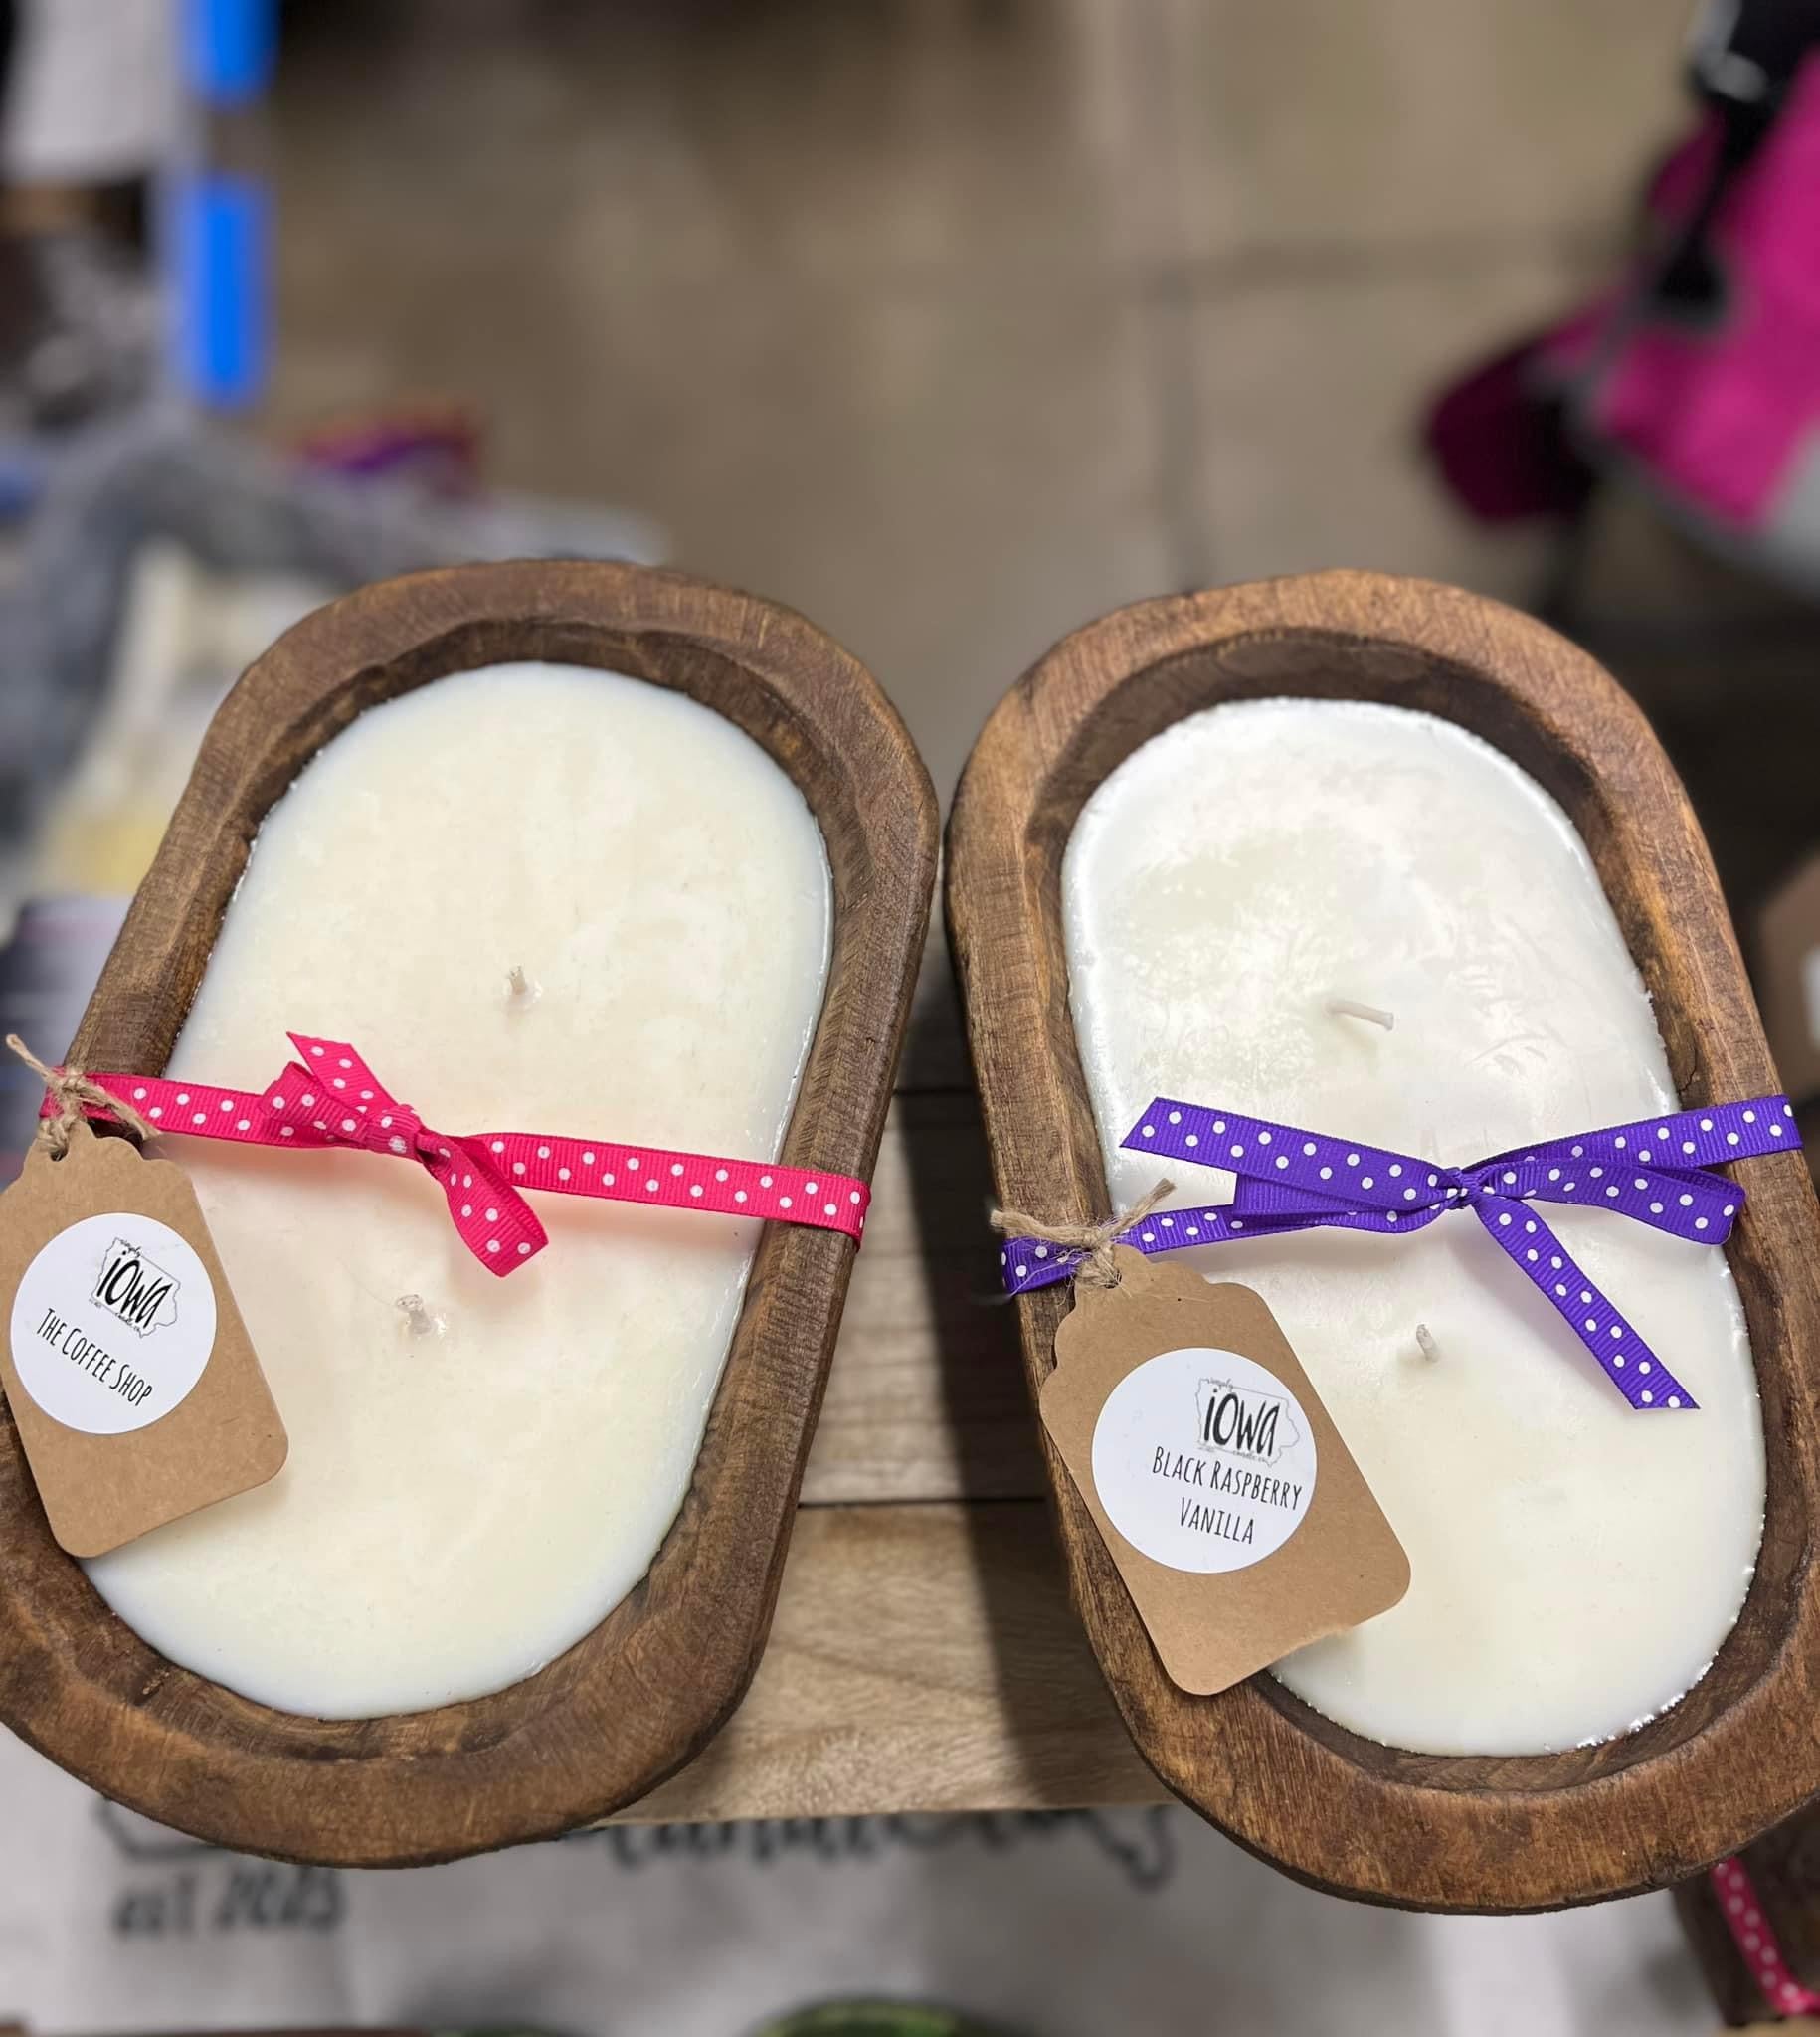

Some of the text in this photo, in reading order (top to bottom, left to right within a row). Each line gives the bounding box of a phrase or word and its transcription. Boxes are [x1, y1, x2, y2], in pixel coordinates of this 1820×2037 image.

[36, 1307, 67, 1346] THE
[62, 1328, 116, 1383] COFFEE
[109, 1364, 153, 1406] SHOP
[1152, 1446, 1303, 1511] BLACK RASPBERRY
[1180, 1496, 1255, 1544] VANILLA
